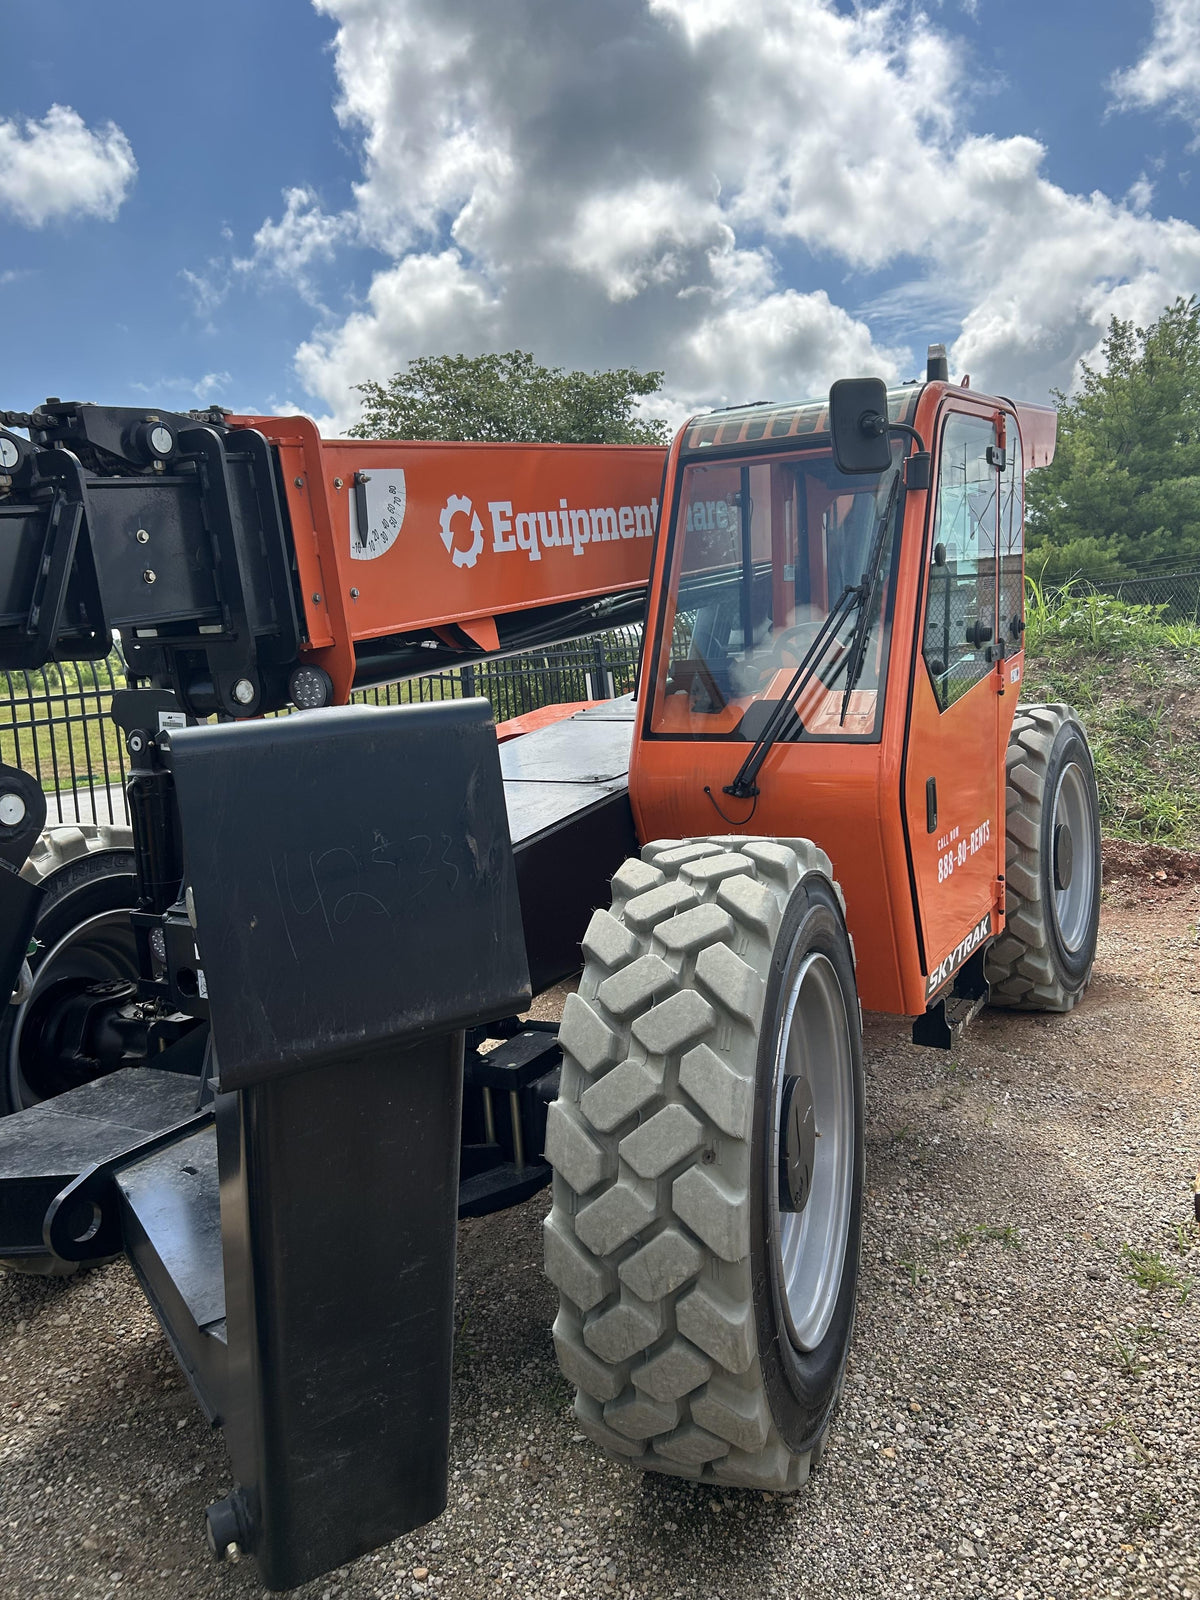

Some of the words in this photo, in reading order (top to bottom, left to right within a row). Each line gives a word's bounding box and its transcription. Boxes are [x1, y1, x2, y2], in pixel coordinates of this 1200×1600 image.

[388, 485, 397, 495] 80
[393, 496, 402, 507] 70
[387, 503, 396, 515] 60
[381, 518, 390, 530] 40
[389, 516, 398, 529] 50
[372, 528, 380, 542] 20
[368, 540, 376, 552] 10
[937, 834, 949, 852] CALL
[938, 819, 990, 883] 888-80-RENTS
[928, 915, 990, 994] SKYTRAK
